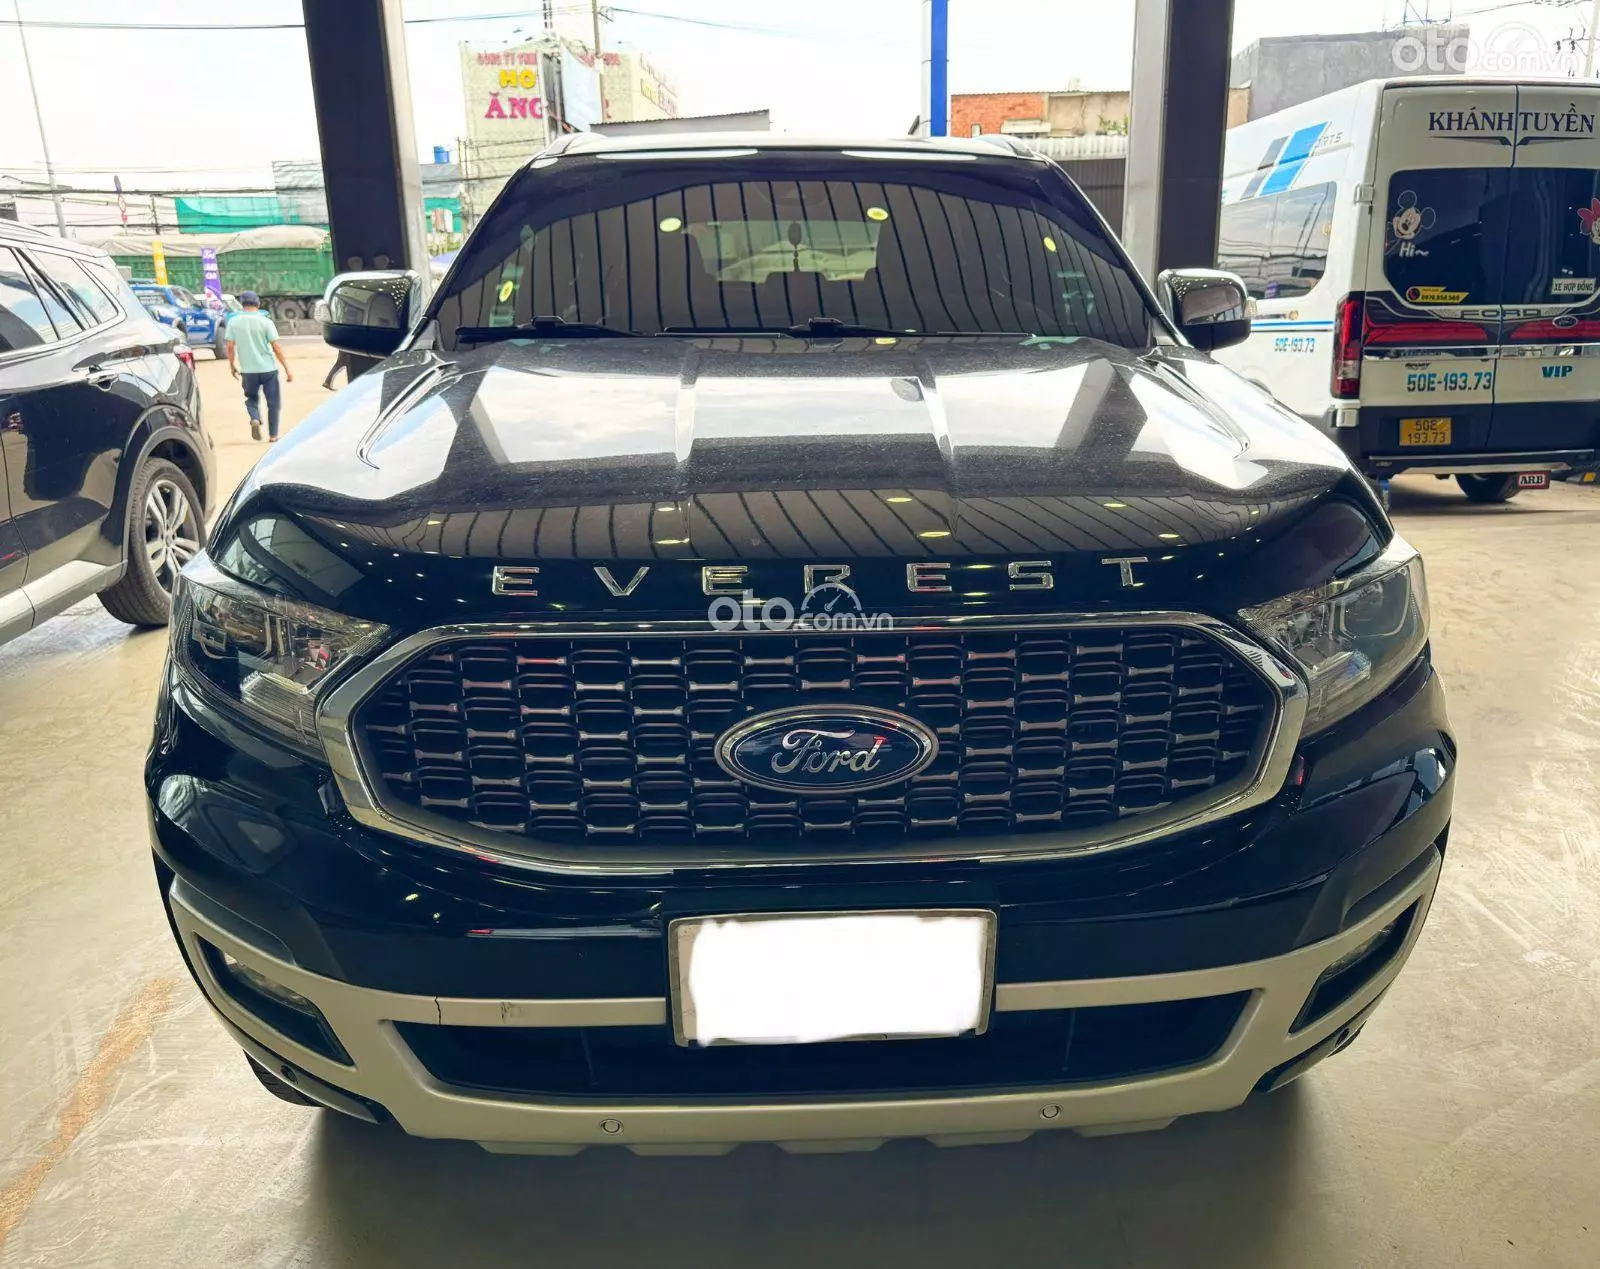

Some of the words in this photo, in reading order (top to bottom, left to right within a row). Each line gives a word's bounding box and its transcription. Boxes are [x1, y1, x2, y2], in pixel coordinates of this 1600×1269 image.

[1428, 107, 1513, 131] KHÁNH
[1519, 103, 1595, 133] TUYỀN
[1542, 366, 1573, 378] VIP
[1407, 372, 1492, 392] 50E-193.73
[1415, 419, 1437, 431] 50E
[1407, 432, 1446, 444] 193.73
[1520, 474, 1545, 485] ARB
[492, 556, 1149, 598] EVEREST
[771, 729, 888, 774] Ford
